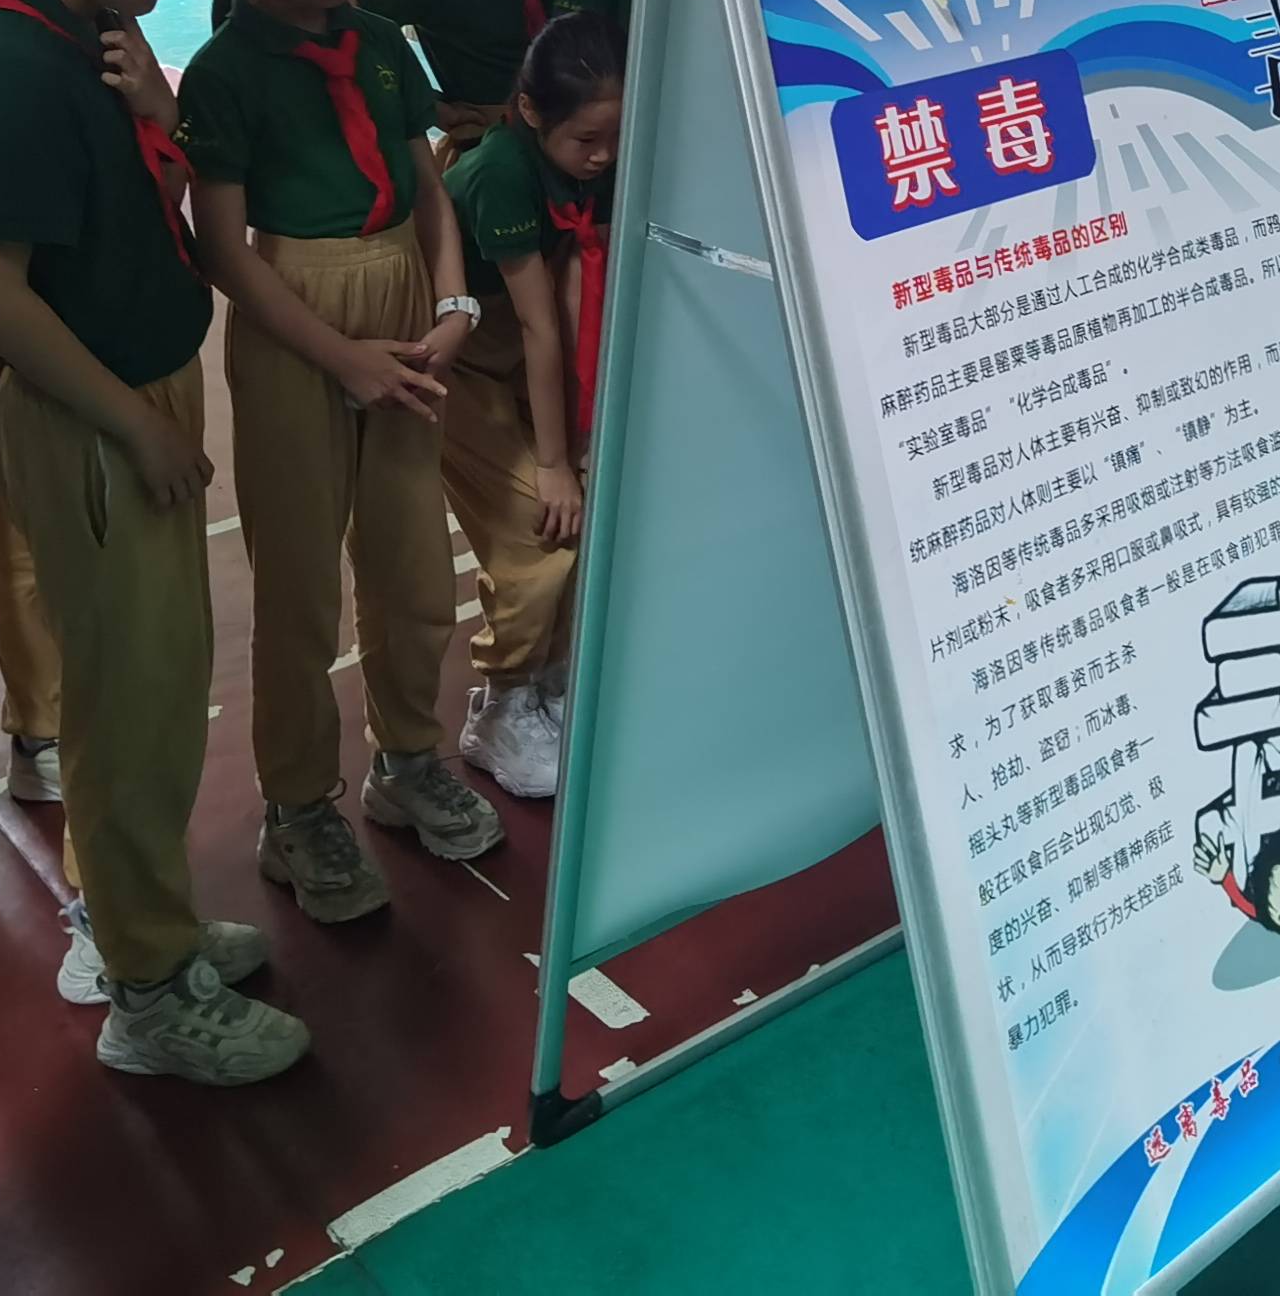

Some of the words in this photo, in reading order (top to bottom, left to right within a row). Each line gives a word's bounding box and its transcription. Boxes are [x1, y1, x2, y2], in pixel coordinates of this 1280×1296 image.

[872, 70, 1057, 214] 禁毒
[890, 210, 1129, 311] 新型毒品与传统毒品的区别
[1005, 983, 1079, 1053] 暴力犯罪。
[1140, 1049, 1262, 1172] 远离毒品
